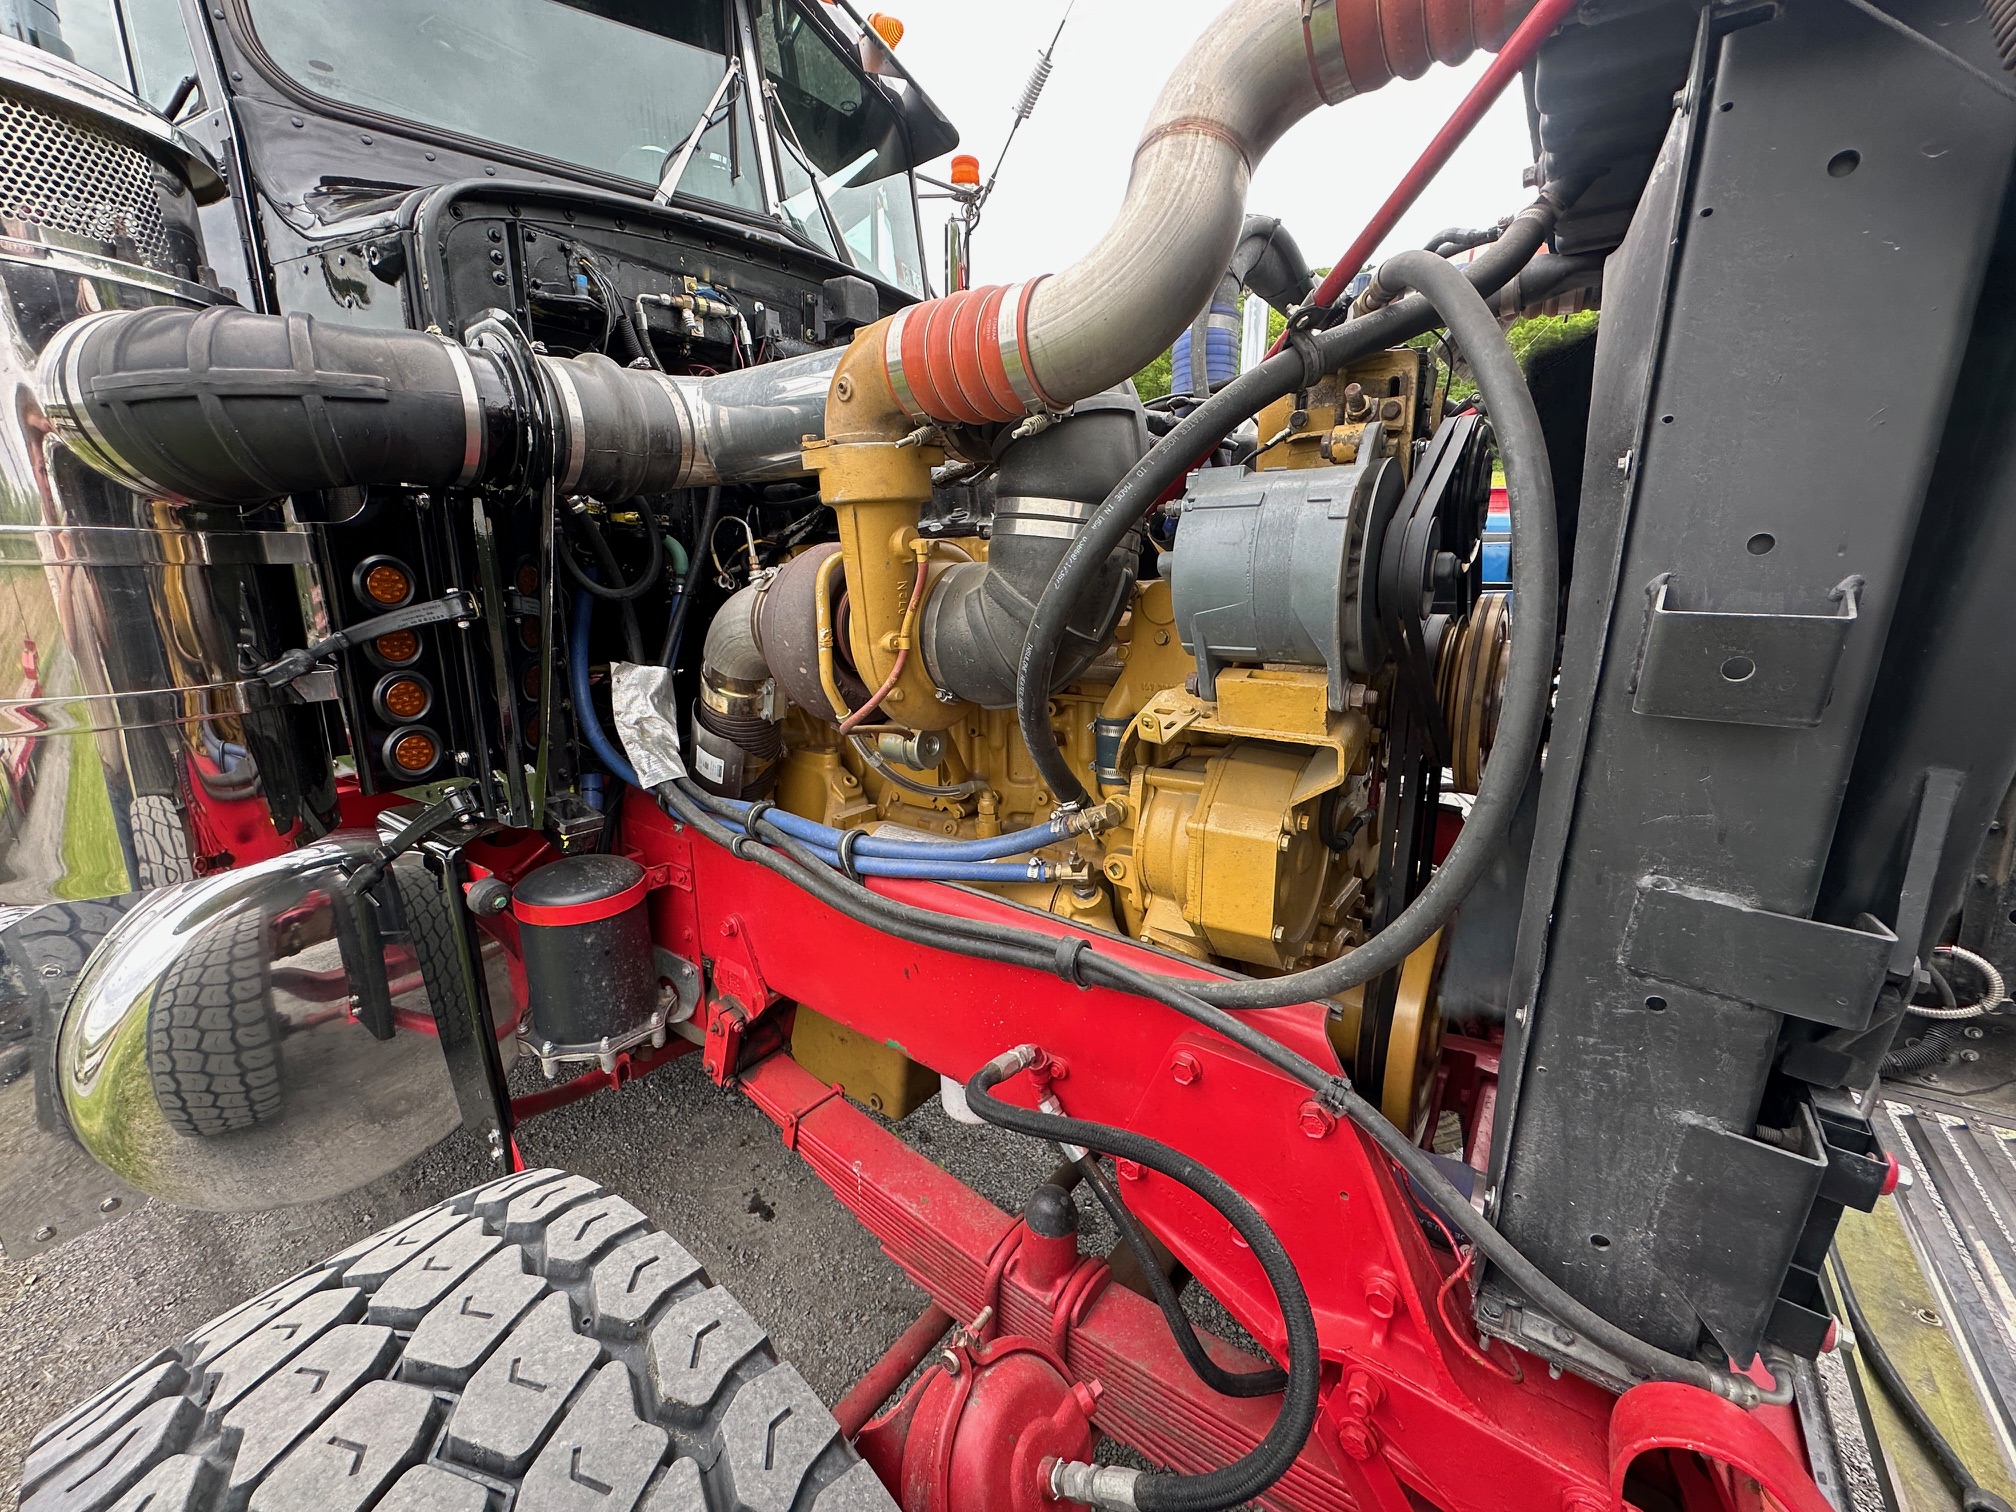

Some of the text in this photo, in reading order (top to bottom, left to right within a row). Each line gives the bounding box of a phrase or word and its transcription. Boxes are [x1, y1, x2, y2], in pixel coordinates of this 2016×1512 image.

[1366, 313, 1385, 324] USA
[1180, 410, 1209, 436] HEATER
[1159, 435, 1180, 455] HOSE
[1114, 482, 1133, 502] MADE
[1104, 503, 1115, 516] IN
[1091, 515, 1106, 530] USA
[1019, 674, 1027, 696] HEATER
